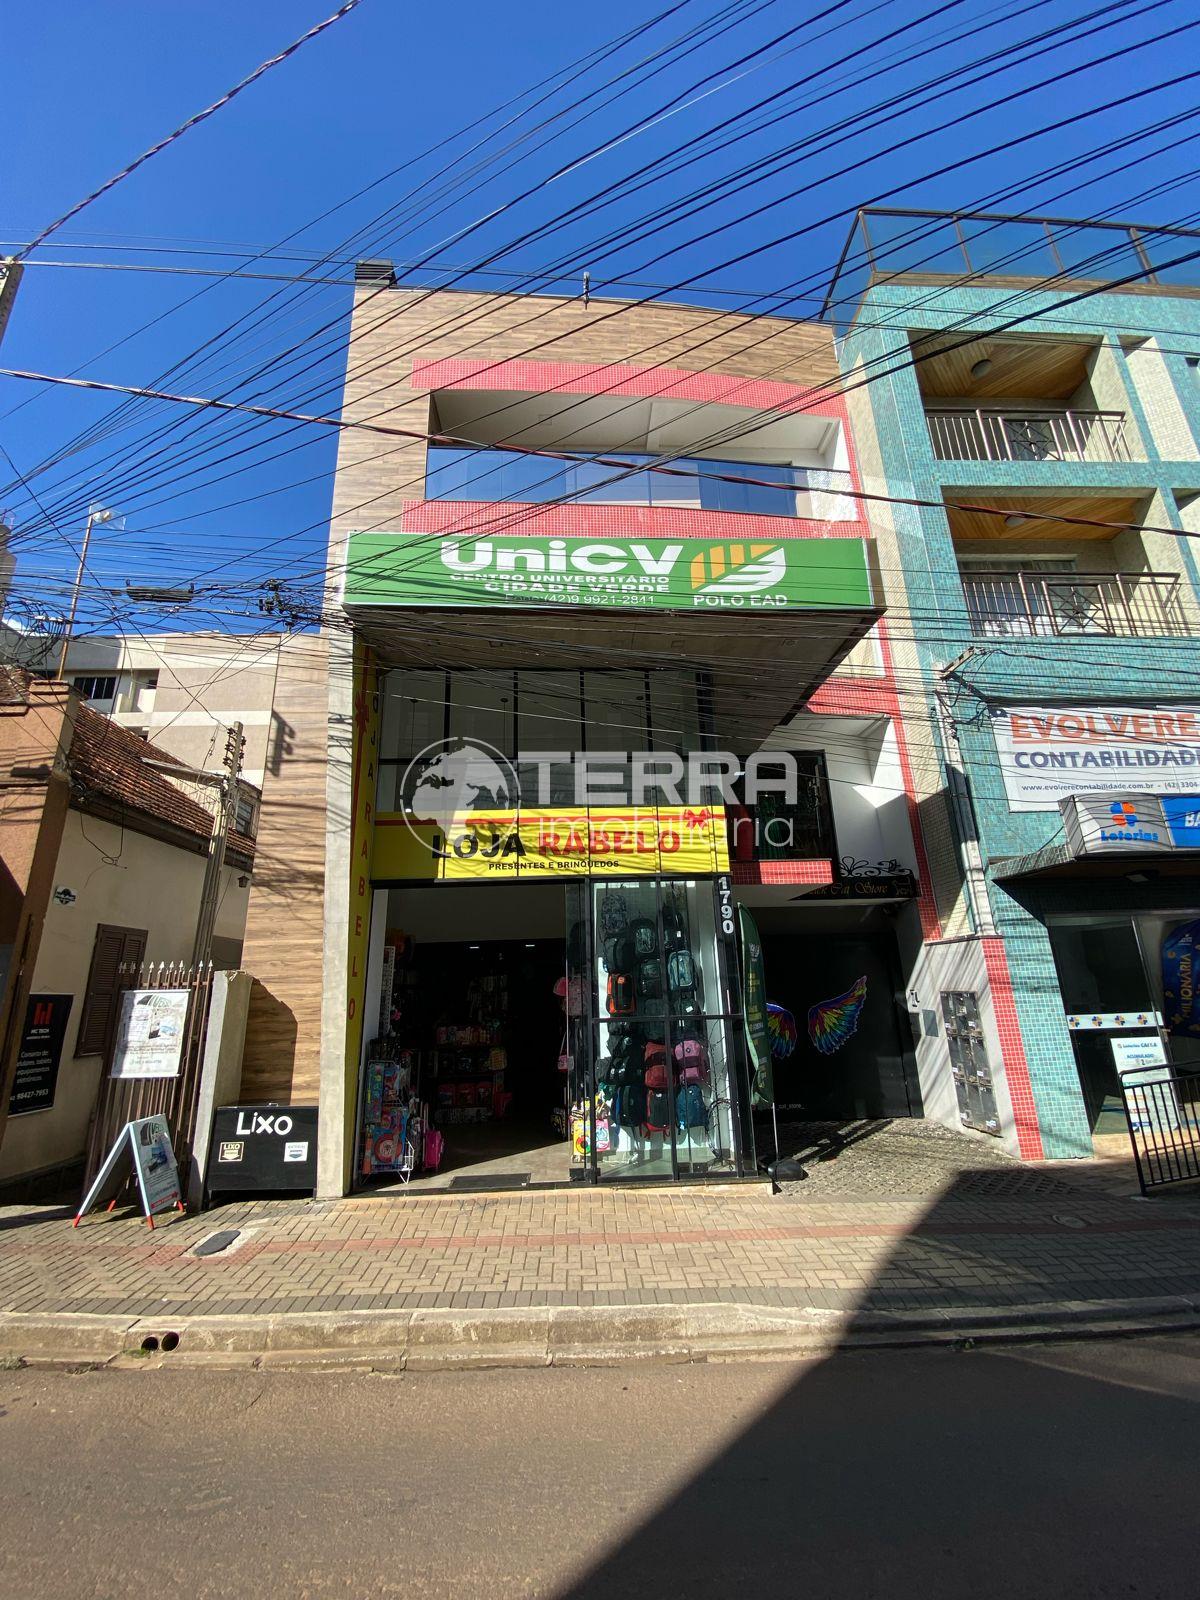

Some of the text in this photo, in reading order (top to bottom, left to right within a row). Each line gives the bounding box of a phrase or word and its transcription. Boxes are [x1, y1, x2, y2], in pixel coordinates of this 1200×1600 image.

[440, 540, 684, 575] UniCV
[450, 573, 670, 584] CENTRO UNIVERSITÁRIO
[484, 582, 670, 593] CIDADE VERDE
[693, 594, 788, 607] POLO EAD
[1010, 713, 1200, 738] EVOLVERE
[1022, 782, 1154, 791] www.evolverecontabilidade.com.br
[1100, 827, 1159, 842] Loterias
[432, 829, 681, 859] LOJA RABELO
[488, 860, 620, 870] PRESENTES E BRINQUEDOS
[718, 876, 734, 934] 1790
